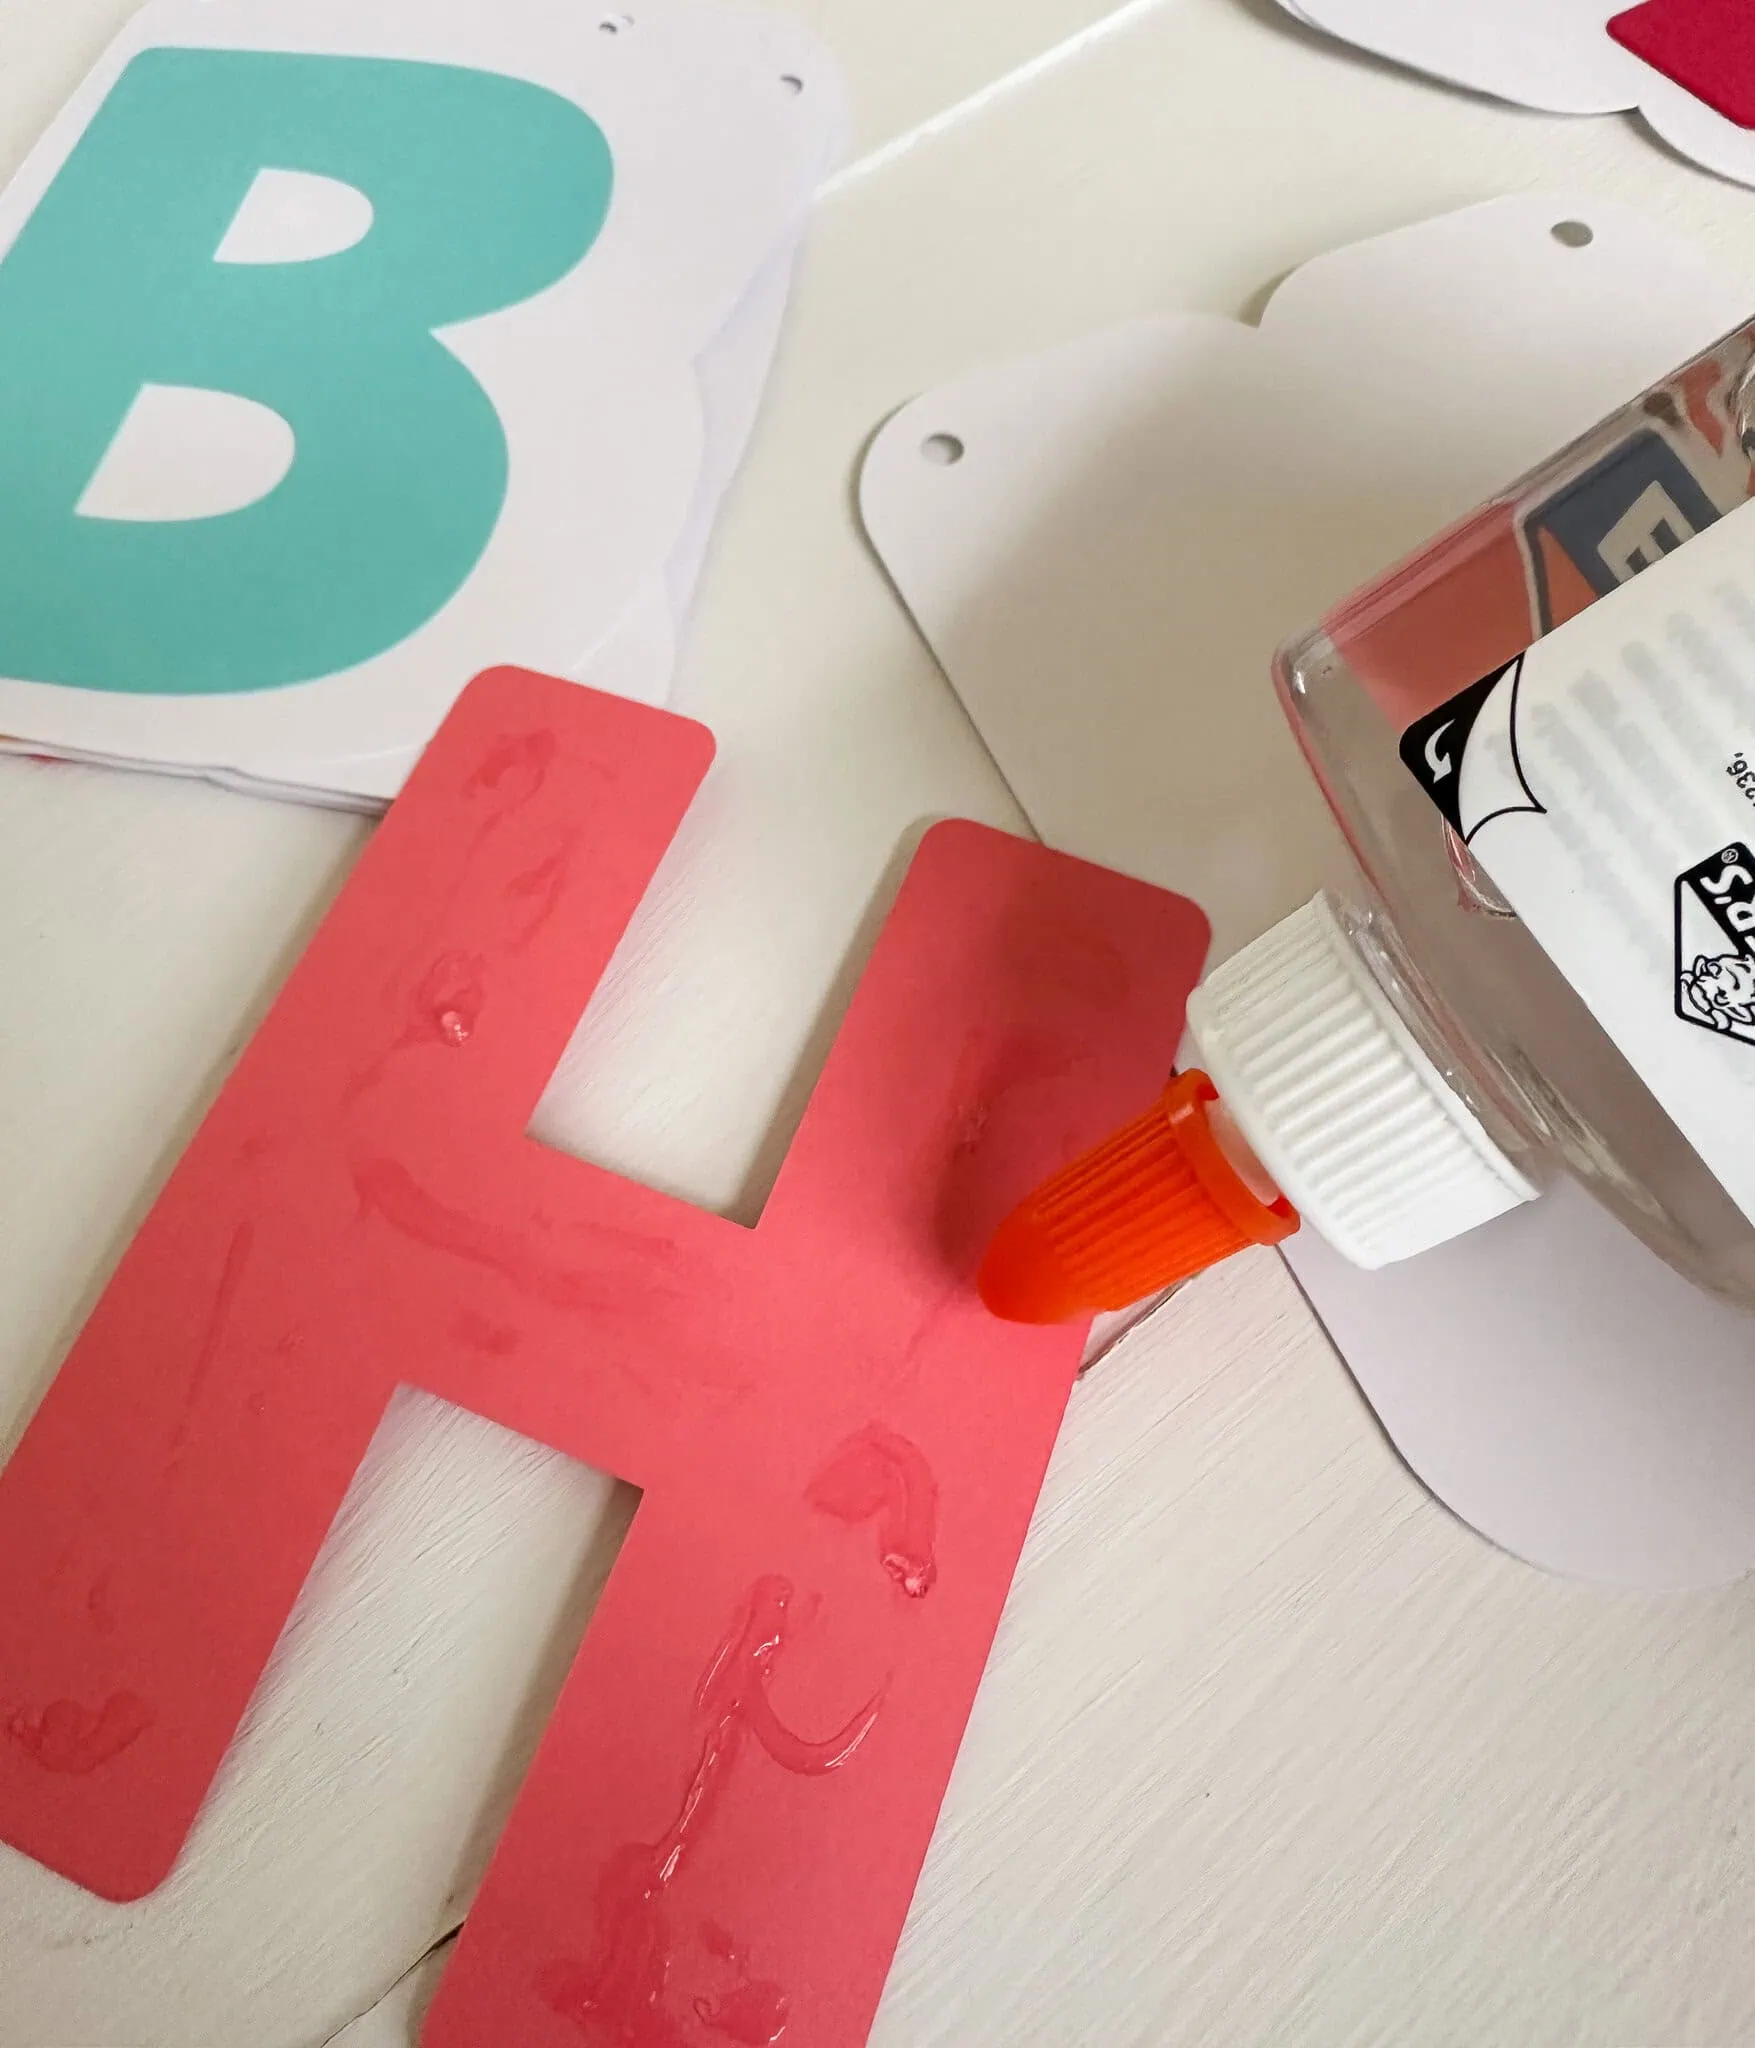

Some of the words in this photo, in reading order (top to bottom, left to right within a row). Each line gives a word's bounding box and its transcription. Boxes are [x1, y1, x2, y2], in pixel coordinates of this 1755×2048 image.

[0, 45, 615, 696] B
[1699, 864, 1755, 945] R'S
[1726, 752, 1755, 807] 236,
[0, 664, 1213, 2048] H
